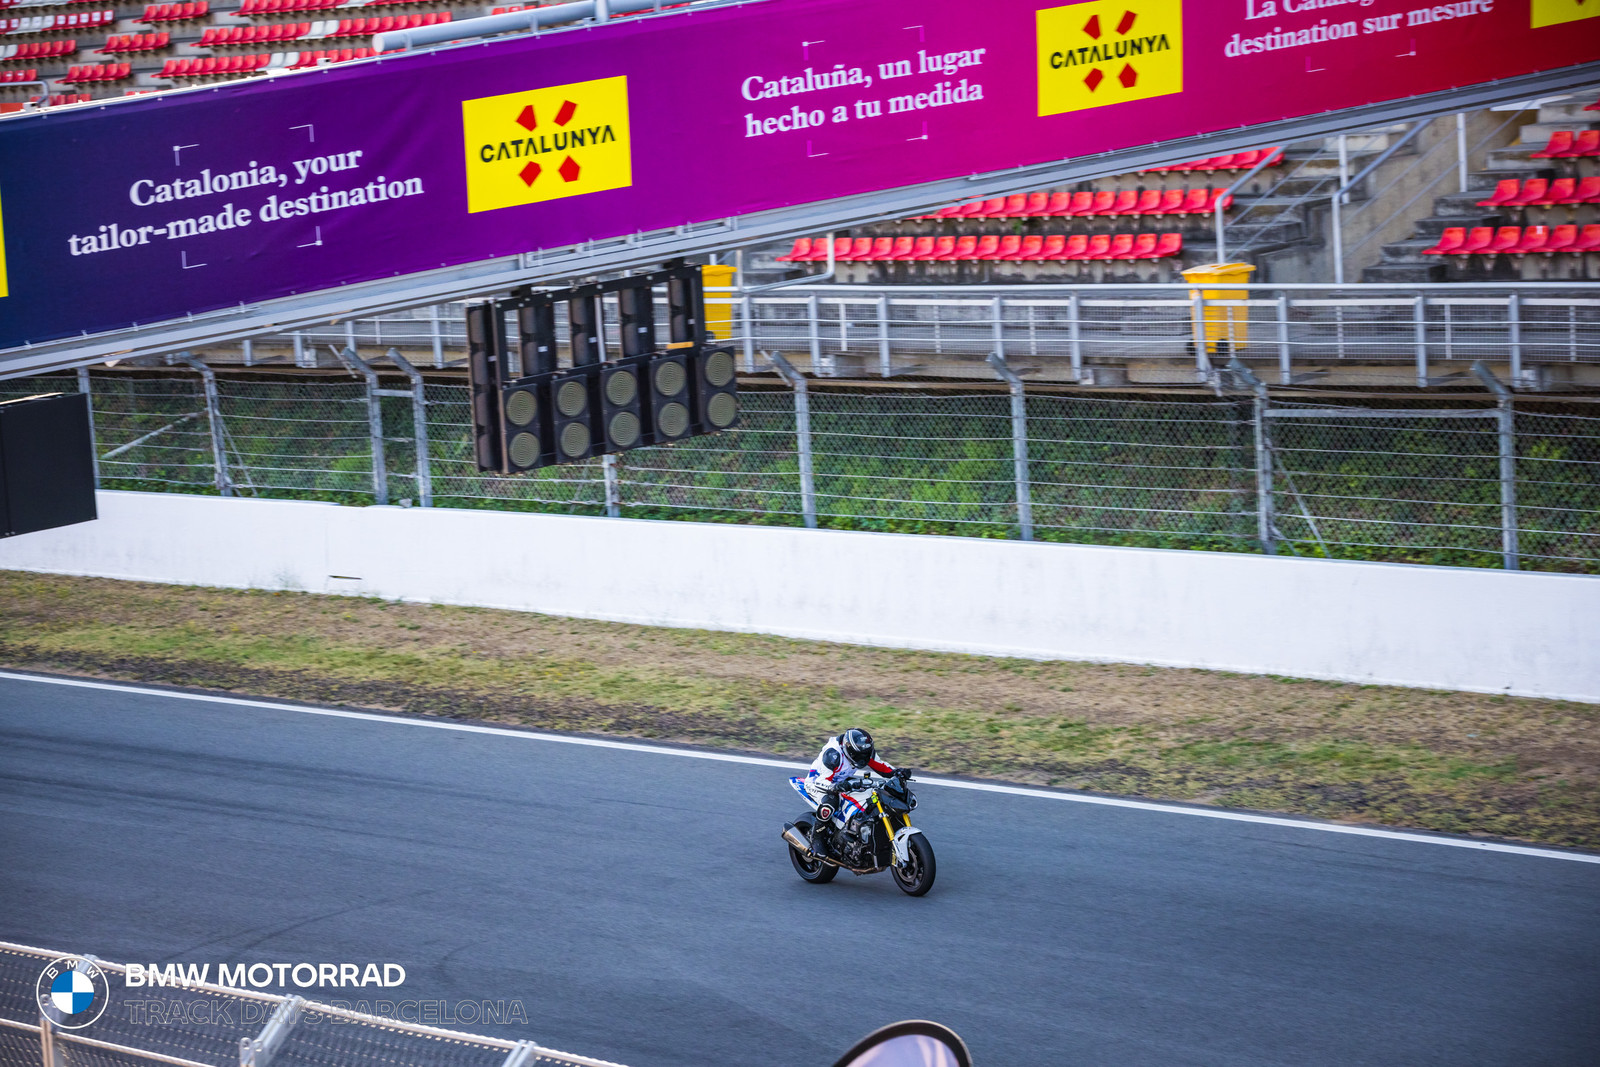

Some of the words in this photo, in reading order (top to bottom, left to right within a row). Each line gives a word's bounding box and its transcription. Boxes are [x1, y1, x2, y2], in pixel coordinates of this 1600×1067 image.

[1224, 18, 1358, 57] destination
[1362, 13, 1403, 34] sur
[1407, 0, 1494, 26] mesure
[1244, 0, 1278, 20] La
[741, 63, 873, 101] Cataluña,
[878, 59, 913, 80] un
[917, 48, 986, 75] lugar
[1050, 33, 1170, 69] CATALUNYA
[744, 105, 825, 138] hecho
[832, 105, 849, 123] a
[854, 99, 882, 119] tu
[888, 79, 984, 114] medida
[480, 125, 617, 163] CATALUNYA
[129, 160, 289, 206] Catalonia,
[293, 150, 363, 184] your
[68, 203, 252, 256] tailor-made
[259, 175, 424, 222] destination
